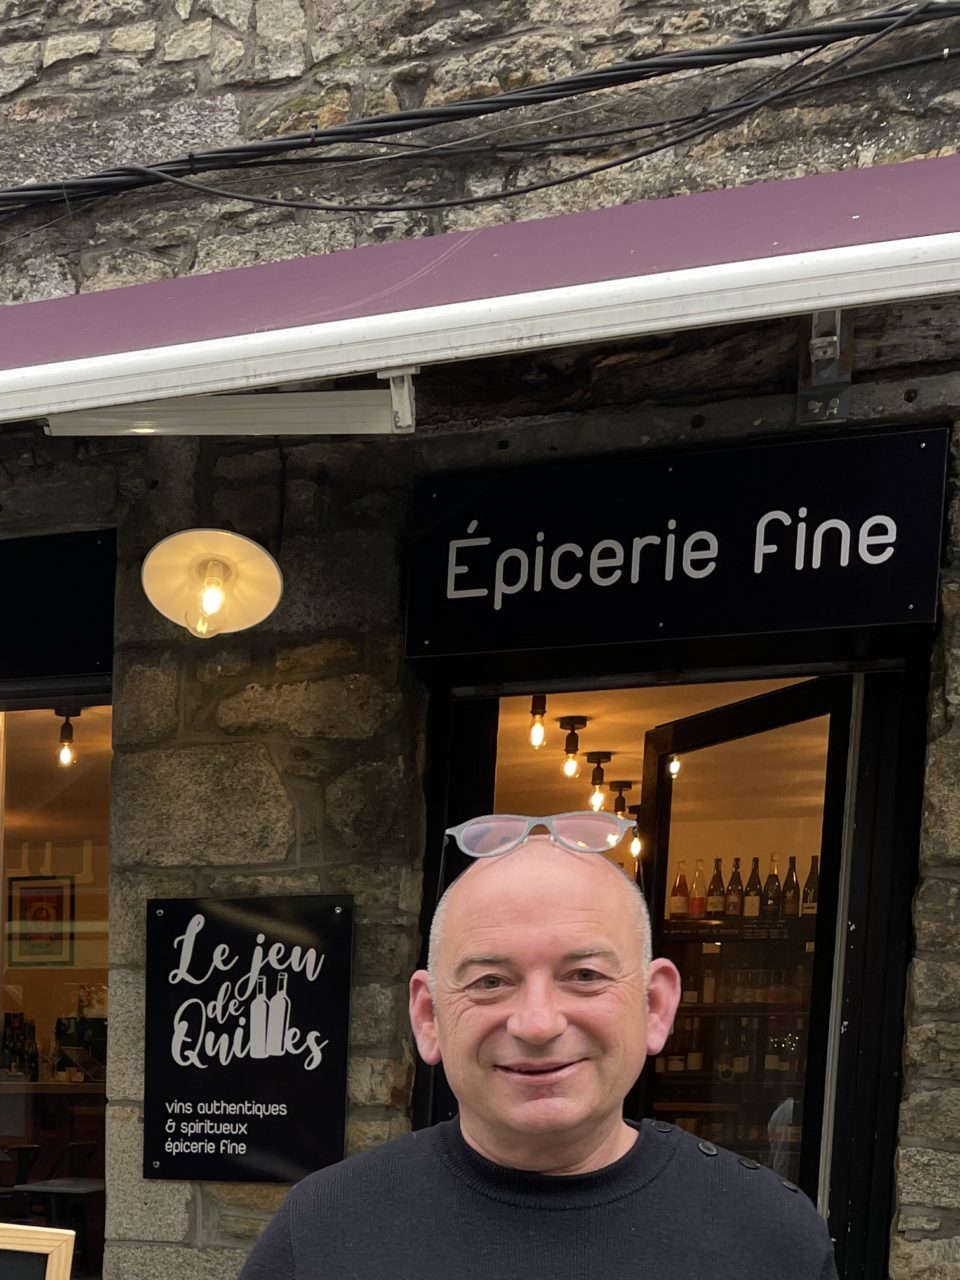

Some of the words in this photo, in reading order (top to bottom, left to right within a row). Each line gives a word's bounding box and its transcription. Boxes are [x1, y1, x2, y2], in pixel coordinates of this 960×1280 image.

[446, 519, 719, 610] Épicerie
[754, 507, 897, 574] fine
[168, 913, 239, 985] Le
[207, 982, 244, 1024] de
[165, 1101, 192, 1114] vins
[197, 1100, 287, 1118] authentiques
[165, 1119, 176, 1132] &
[180, 1119, 248, 1136] spiritueux
[165, 1138, 215, 1156] épicerie
[220, 1139, 246, 1154] fine
